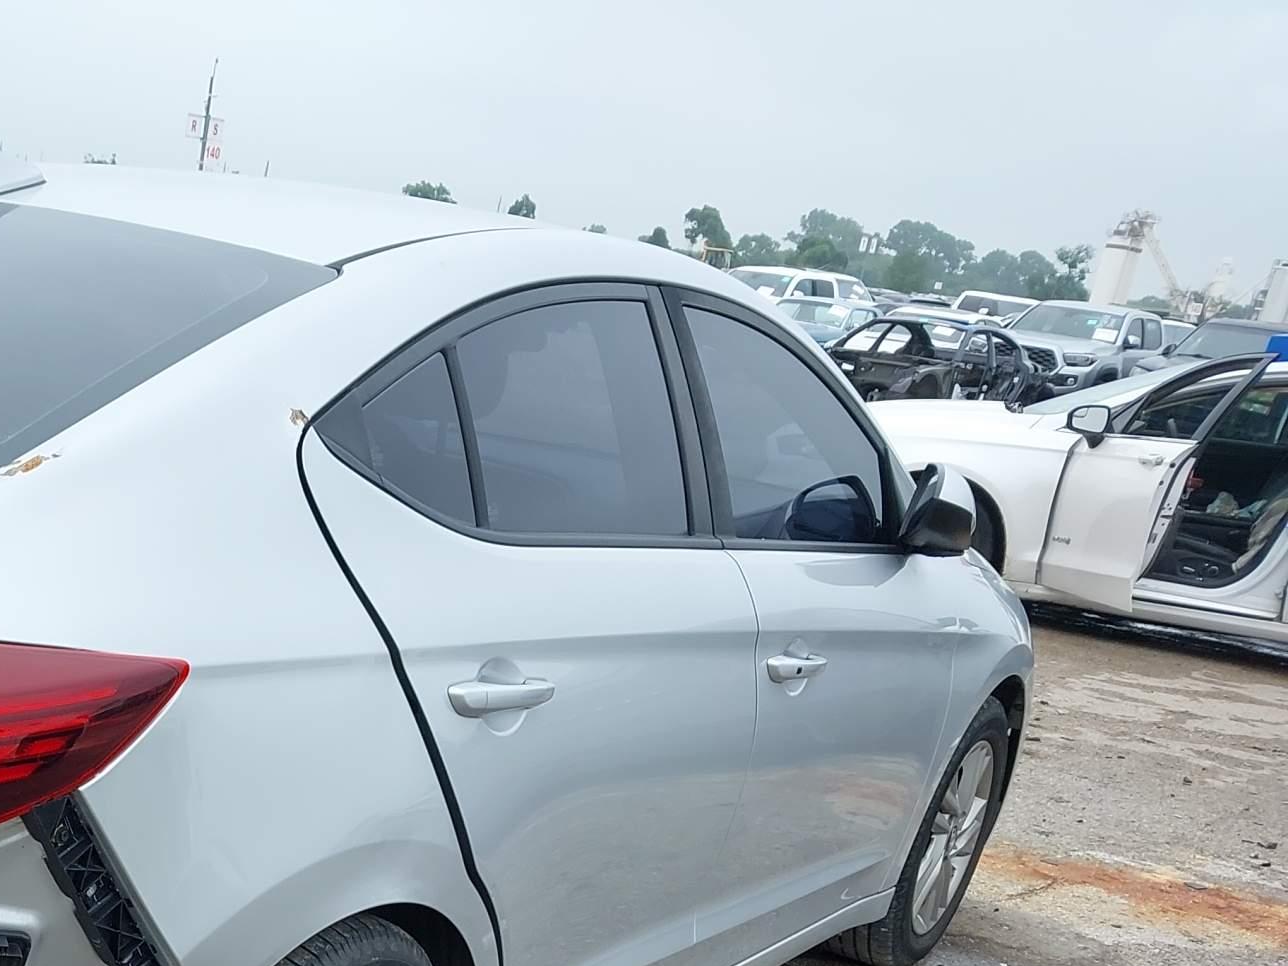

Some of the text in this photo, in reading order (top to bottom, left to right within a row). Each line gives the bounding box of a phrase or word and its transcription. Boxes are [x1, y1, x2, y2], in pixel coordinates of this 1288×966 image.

[191, 120, 197, 132] R
[213, 123, 218, 136] S
[206, 146, 221, 160] 140
